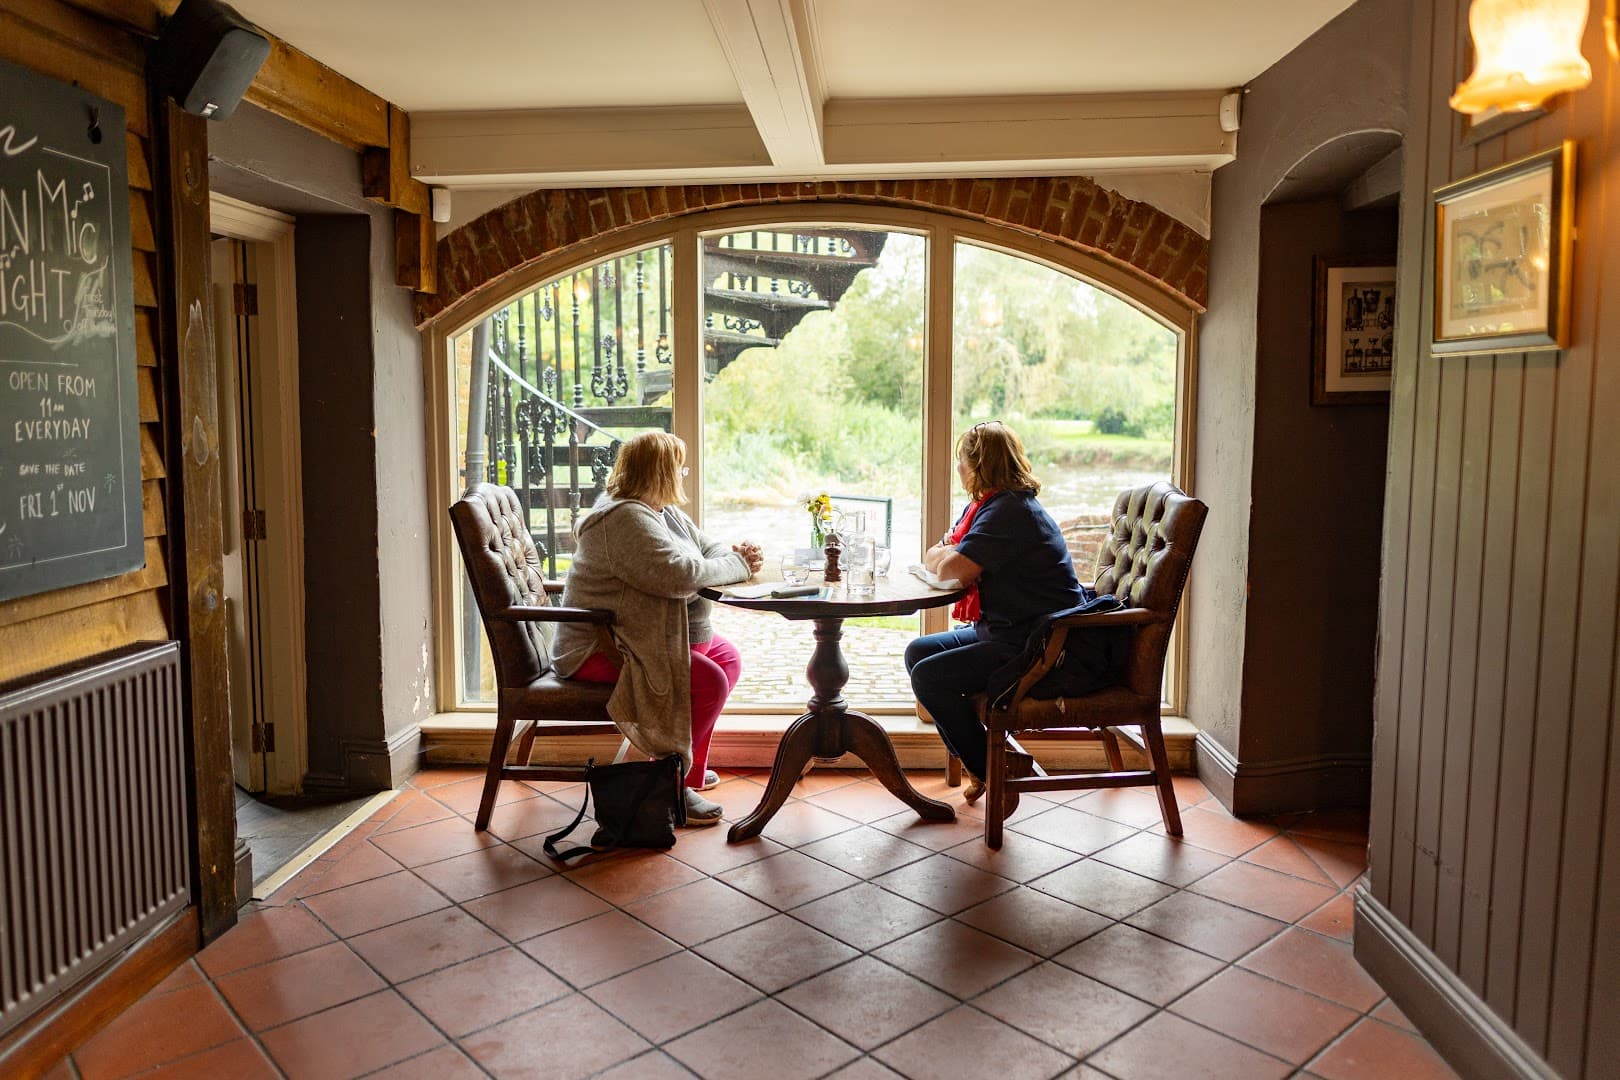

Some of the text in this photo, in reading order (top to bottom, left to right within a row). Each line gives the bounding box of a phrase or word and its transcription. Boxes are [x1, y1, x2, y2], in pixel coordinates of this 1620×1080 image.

[9, 371, 96, 398] OPEN FROM
[15, 417, 91, 442] EVERYDAY
[44, 464, 61, 475] THE
[64, 462, 86, 477] DATE
[20, 493, 44, 520] FRI
[68, 486, 96, 514] NOV
